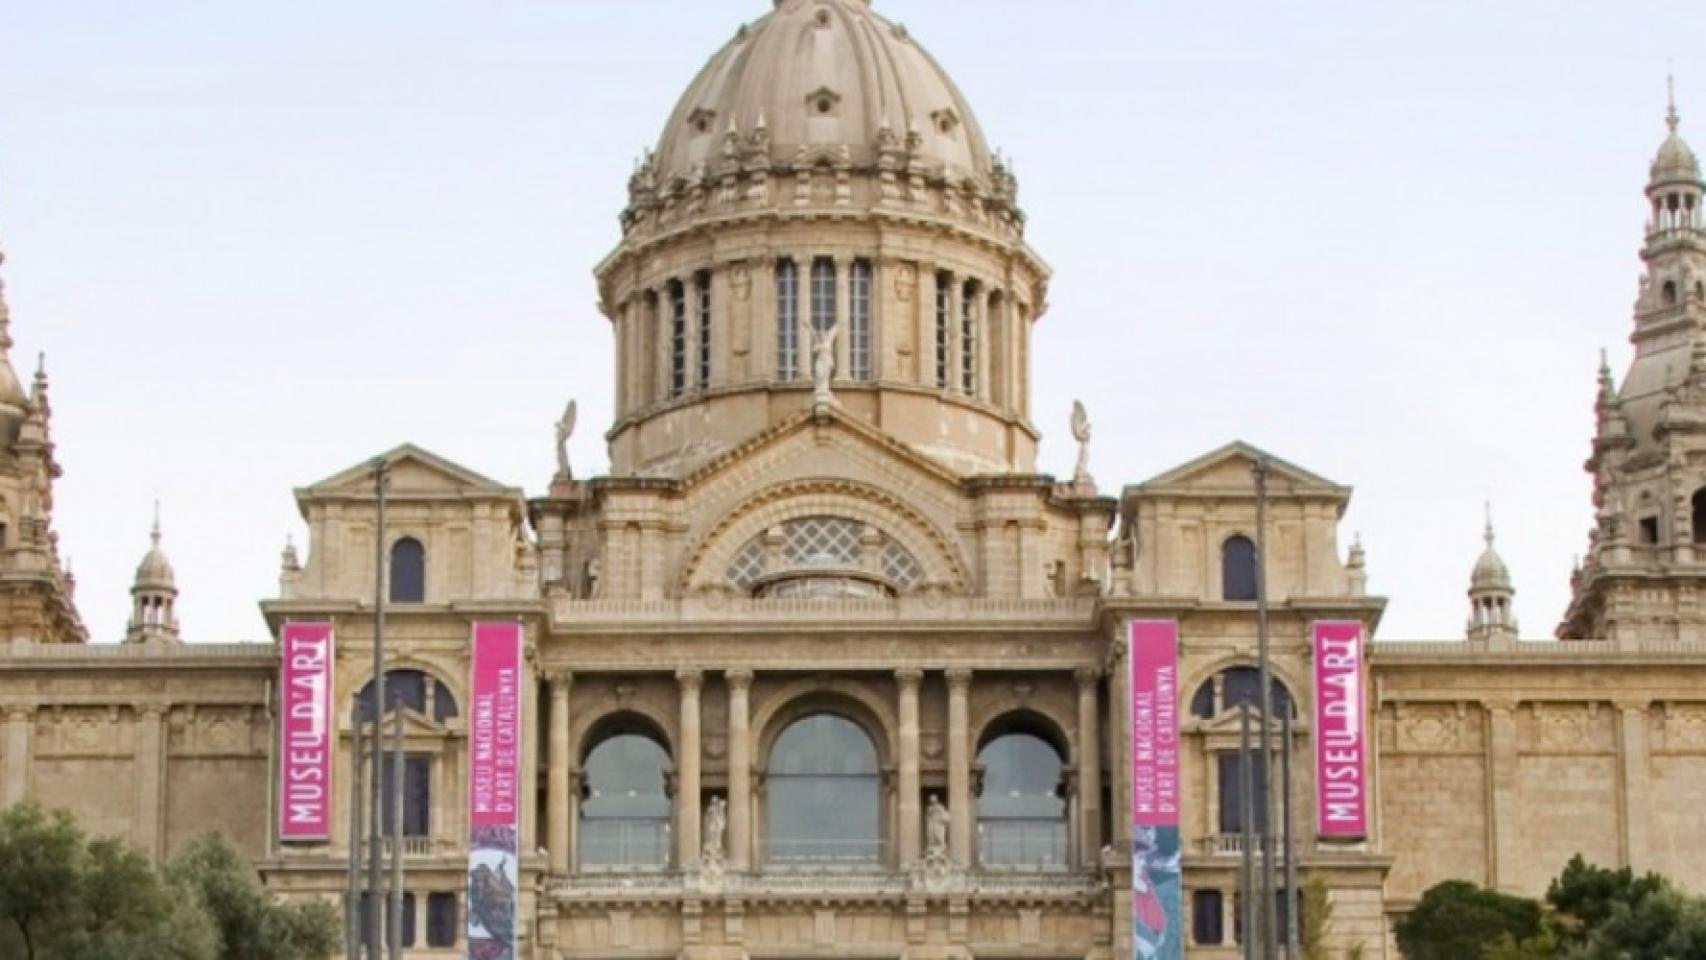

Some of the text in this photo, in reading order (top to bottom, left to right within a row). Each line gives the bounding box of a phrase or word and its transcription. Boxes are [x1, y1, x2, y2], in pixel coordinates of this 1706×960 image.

[289, 638, 327, 823] MUSEU D'ART
[475, 694, 493, 812] MUSEU NACIONAL
[496, 669, 513, 812] D'ART DE CATALUNYA
[1135, 691, 1153, 812] MUSEU NACIONAL
[1156, 667, 1176, 812] D'ART DE CATALUNYA
[1323, 638, 1359, 821] MUSEU D'ART
